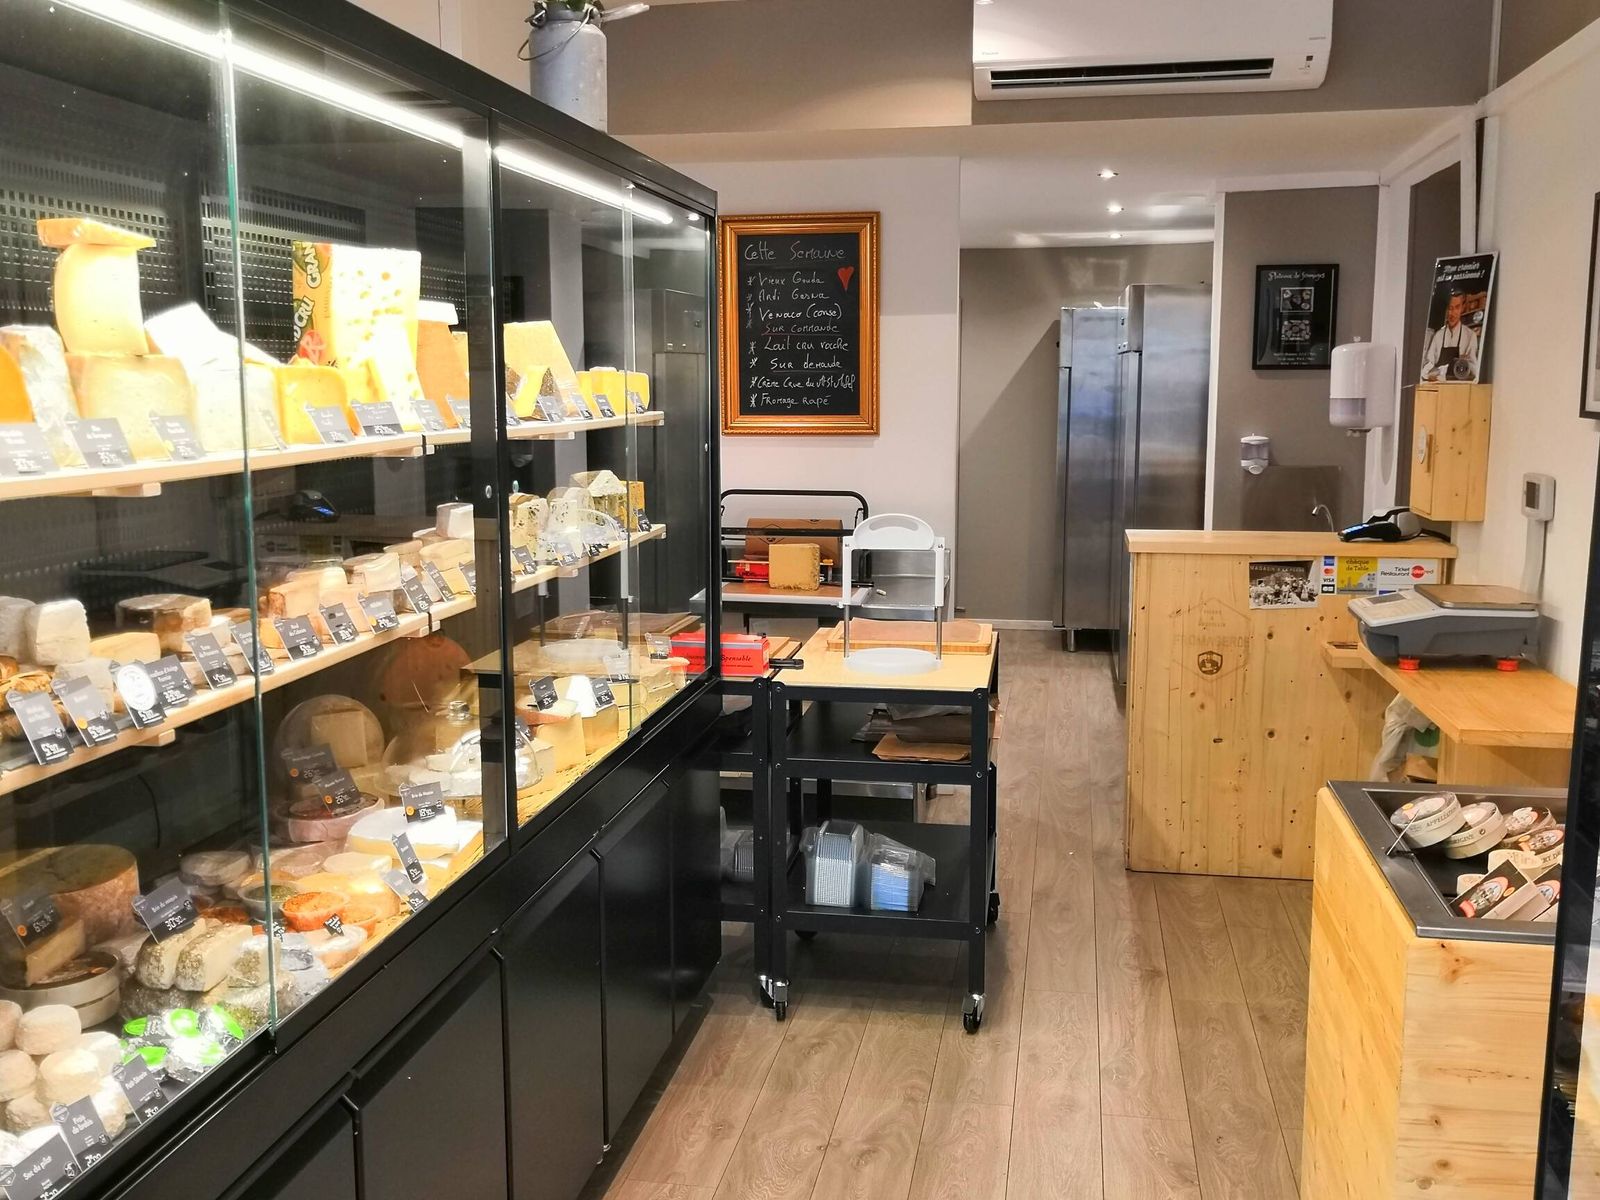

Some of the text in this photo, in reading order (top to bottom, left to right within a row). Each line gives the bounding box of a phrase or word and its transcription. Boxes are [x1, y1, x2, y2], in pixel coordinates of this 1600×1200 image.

[744, 240, 848, 261] Cette Semaine
[758, 271, 825, 286] Vieux Gouda
[764, 335, 791, 351] Lait
[803, 353, 843, 369] demande
[761, 393, 799, 408] Fromage
